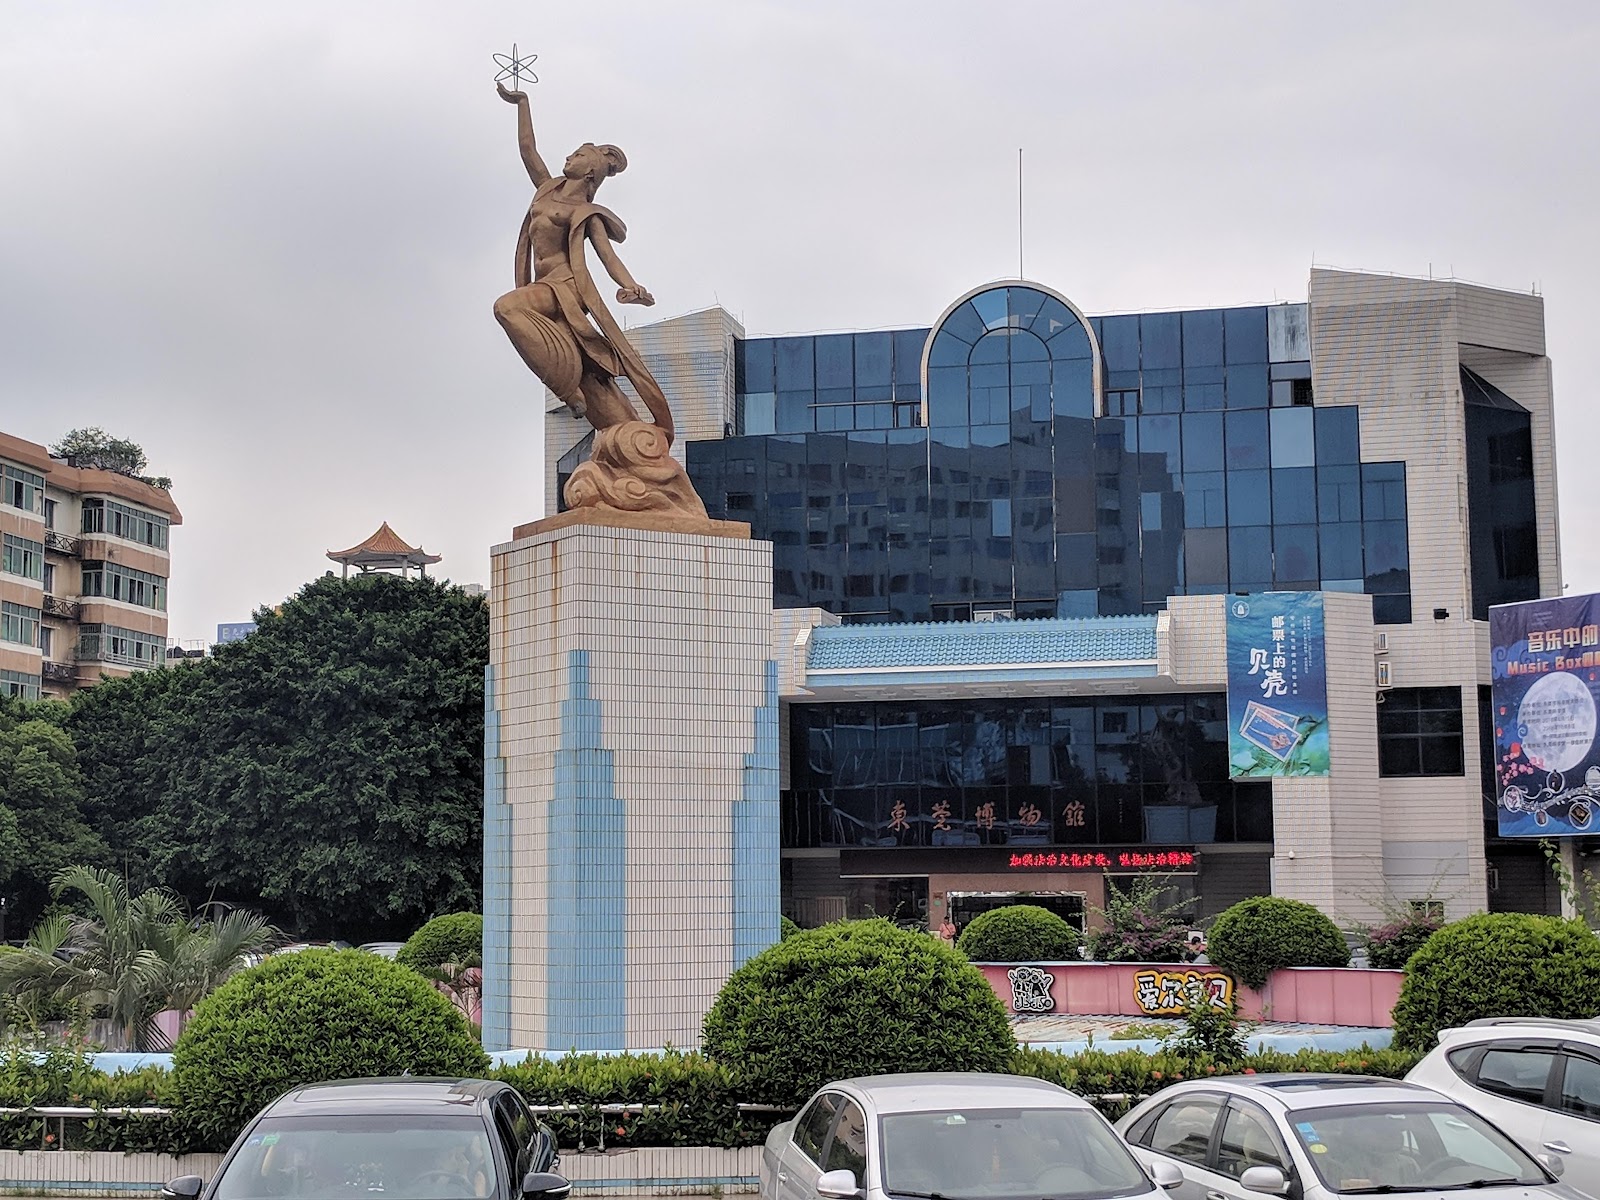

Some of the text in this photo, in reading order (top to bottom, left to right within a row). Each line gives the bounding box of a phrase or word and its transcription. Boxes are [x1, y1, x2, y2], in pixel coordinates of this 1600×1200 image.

[1271, 615, 1286, 669] 邮票上的
[1527, 624, 1599, 653] 音乐中的
[1247, 648, 1288, 698] 贝壳
[1507, 658, 1549, 676] Music
